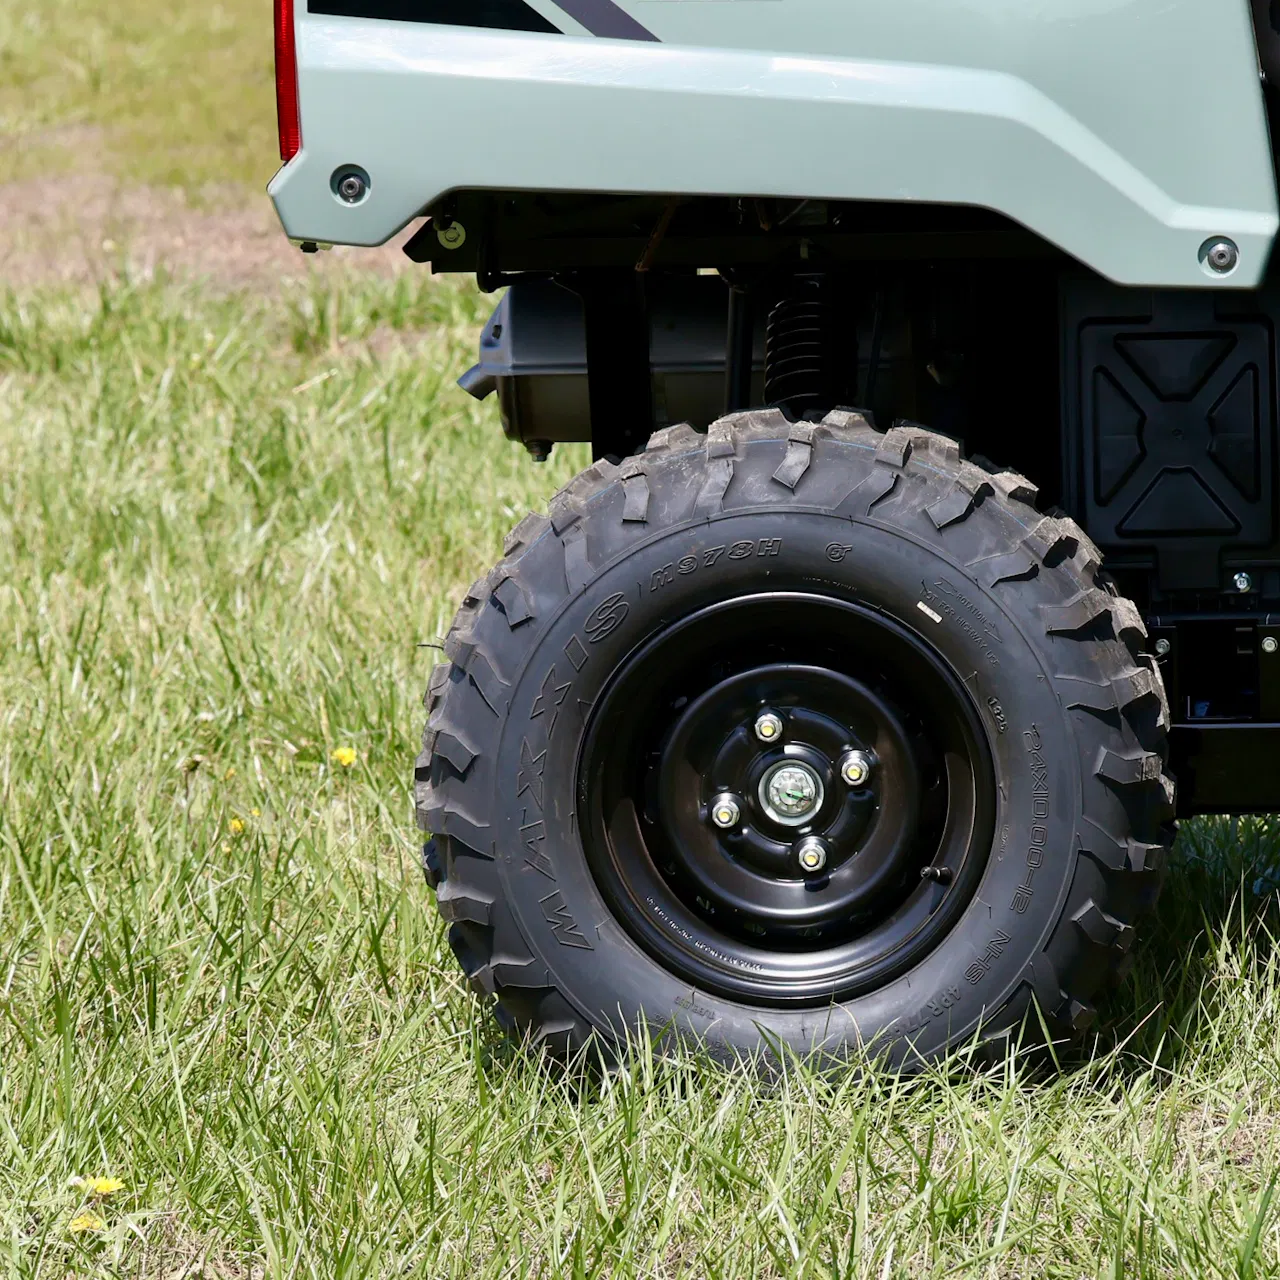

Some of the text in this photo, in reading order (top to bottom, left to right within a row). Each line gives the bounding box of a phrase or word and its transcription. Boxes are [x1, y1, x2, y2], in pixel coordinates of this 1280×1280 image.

[938, 600, 955, 616] FOR
[955, 615, 988, 649] HIGHWAY
[984, 650, 1000, 668] USE
[956, 592, 988, 625] ROTATION
[518, 536, 783, 953] MAXXIS M978H
[963, 928, 1011, 986] NHS
[929, 982, 963, 1019] 4PR
